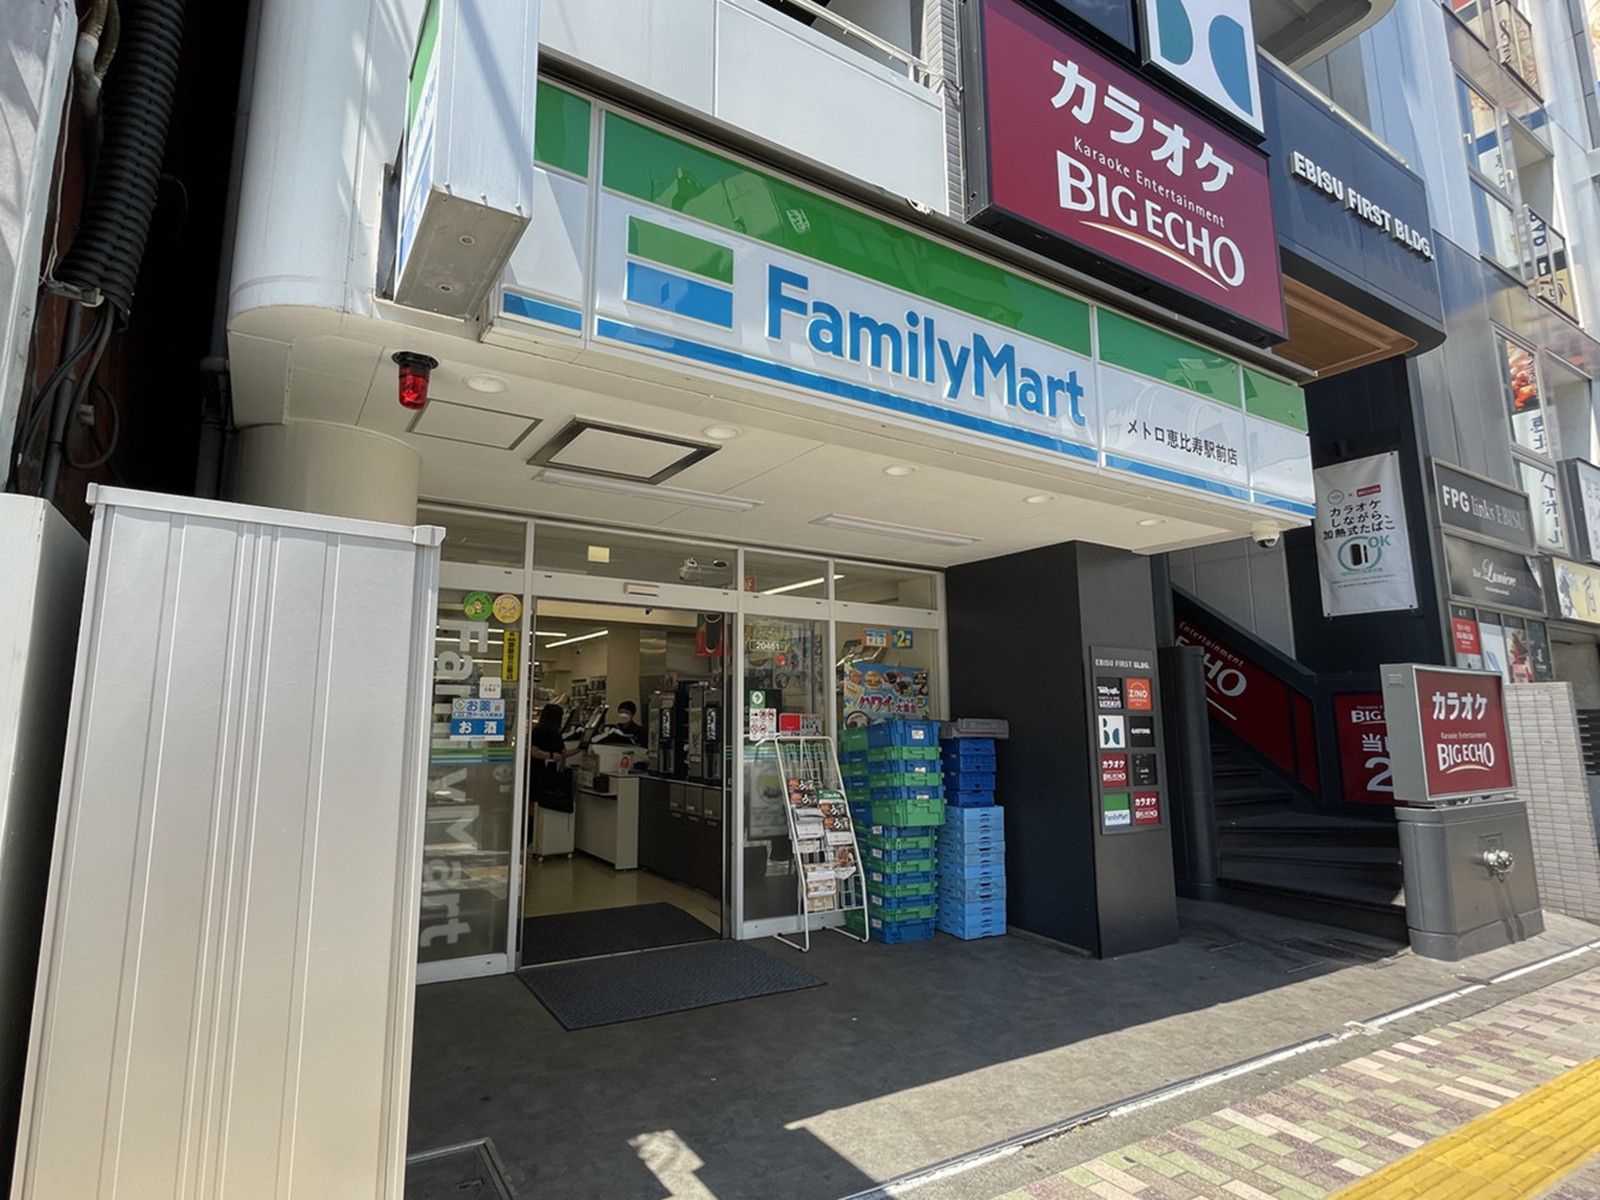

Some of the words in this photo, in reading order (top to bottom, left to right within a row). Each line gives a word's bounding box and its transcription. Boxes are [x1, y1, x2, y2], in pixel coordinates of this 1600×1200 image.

[1051, 60, 1234, 192] カラオケ
[1074, 136, 1131, 178] Karaoke
[1136, 170, 1225, 228] Entertainment
[1056, 150, 1138, 227] BIG
[1145, 199, 1245, 287] ECHO
[1290, 151, 1344, 201] EBISU
[1346, 187, 1391, 232] FIRST
[1394, 218, 1435, 260] BLDG.
[765, 263, 1086, 427] FamilyMart
[1127, 420, 1238, 466] メトロ恵比寿駅前店
[1330, 500, 1381, 517] カラオケ
[1331, 510, 1390, 528] しながら、
[1442, 485, 1470, 512] FPG
[1471, 495, 1495, 521] links
[1496, 504, 1525, 531] EBISU
[1323, 520, 1395, 540] 加熱式たばこ
[1368, 535, 1391, 548] OK
[1179, 621, 1245, 668] Entertainment
[1095, 658, 1114, 667] EBISU
[1115, 660, 1132, 668] FIRST
[1175, 635, 1247, 697] EHO
[1351, 710, 1381, 723] BIG
[1432, 691, 1487, 720] カラオケ
[459, 721, 498, 734] お酒
[1362, 733, 1388, 752] 当
[1437, 743, 1461, 771] BIG
[1462, 742, 1495, 767] ECHO
